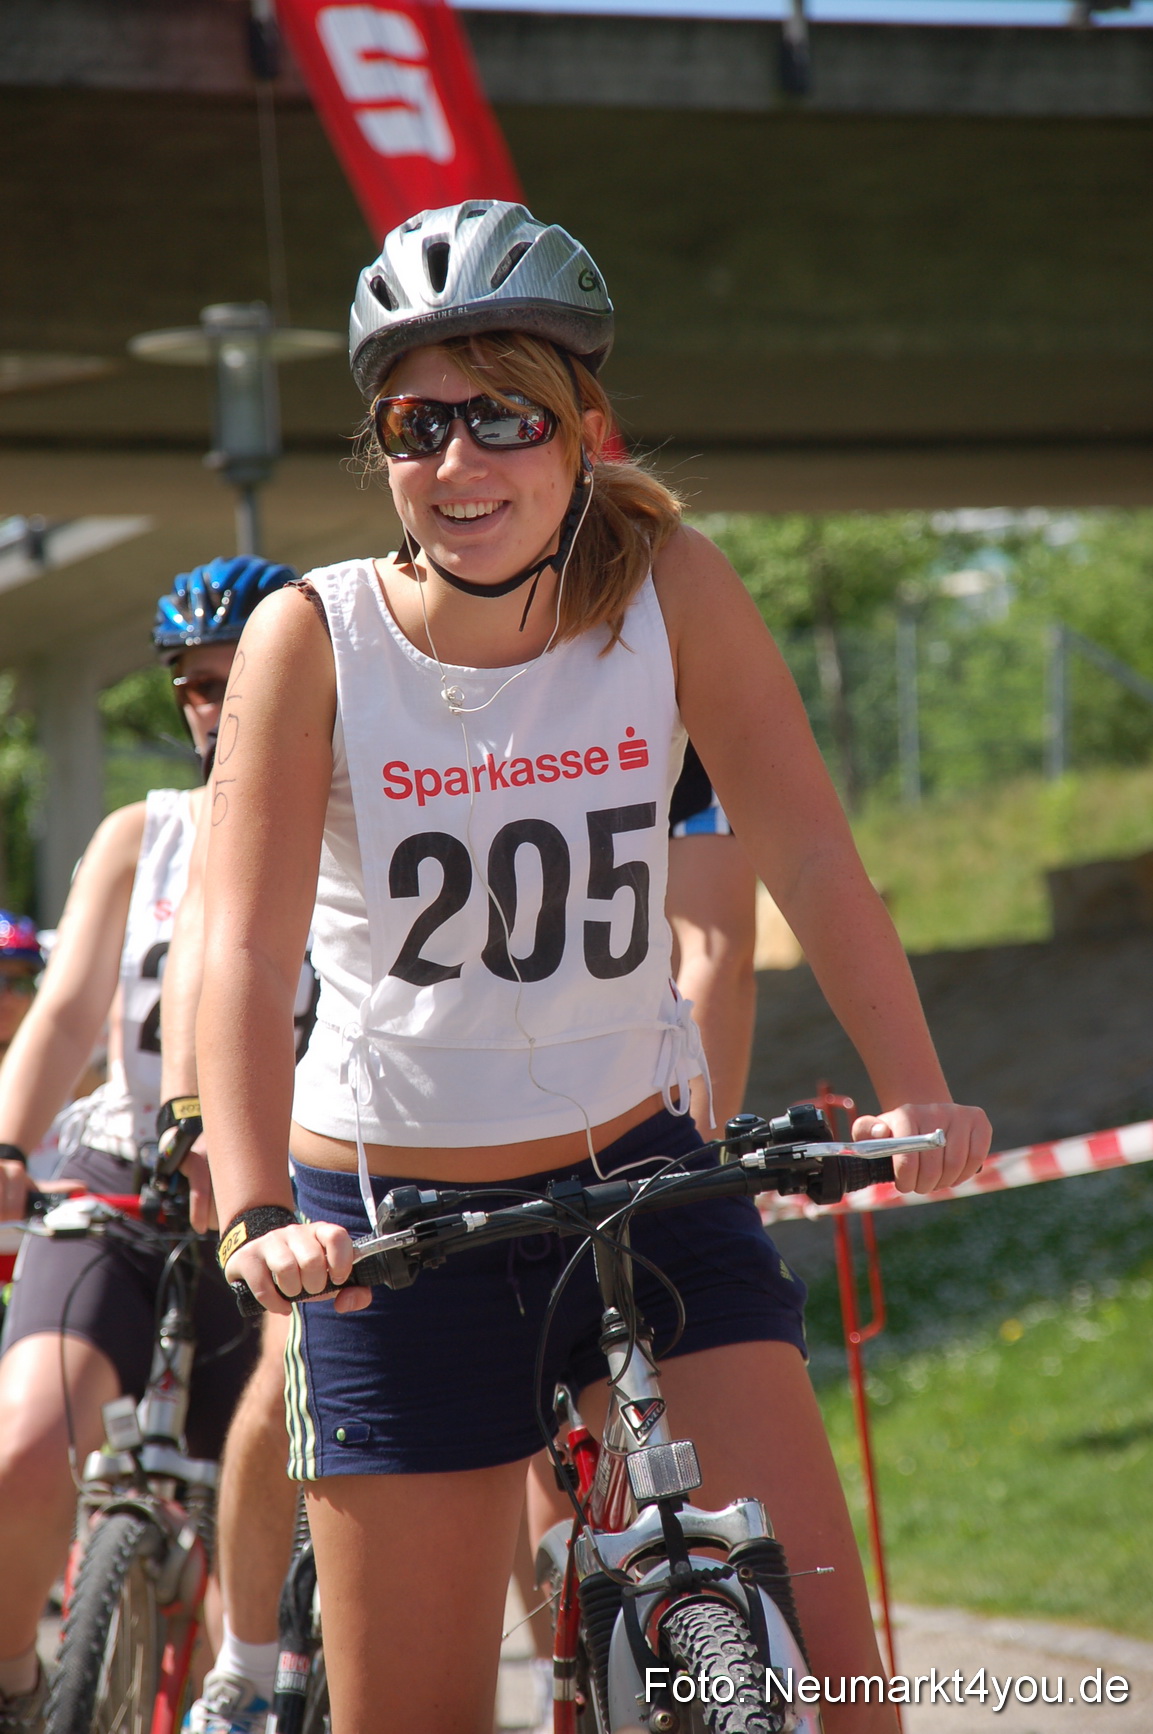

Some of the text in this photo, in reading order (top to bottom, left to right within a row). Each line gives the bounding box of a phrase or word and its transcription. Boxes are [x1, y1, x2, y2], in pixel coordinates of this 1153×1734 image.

[211, 650, 246, 827] 205
[382, 746, 610, 807] Sparkasse
[388, 801, 657, 986] 205
